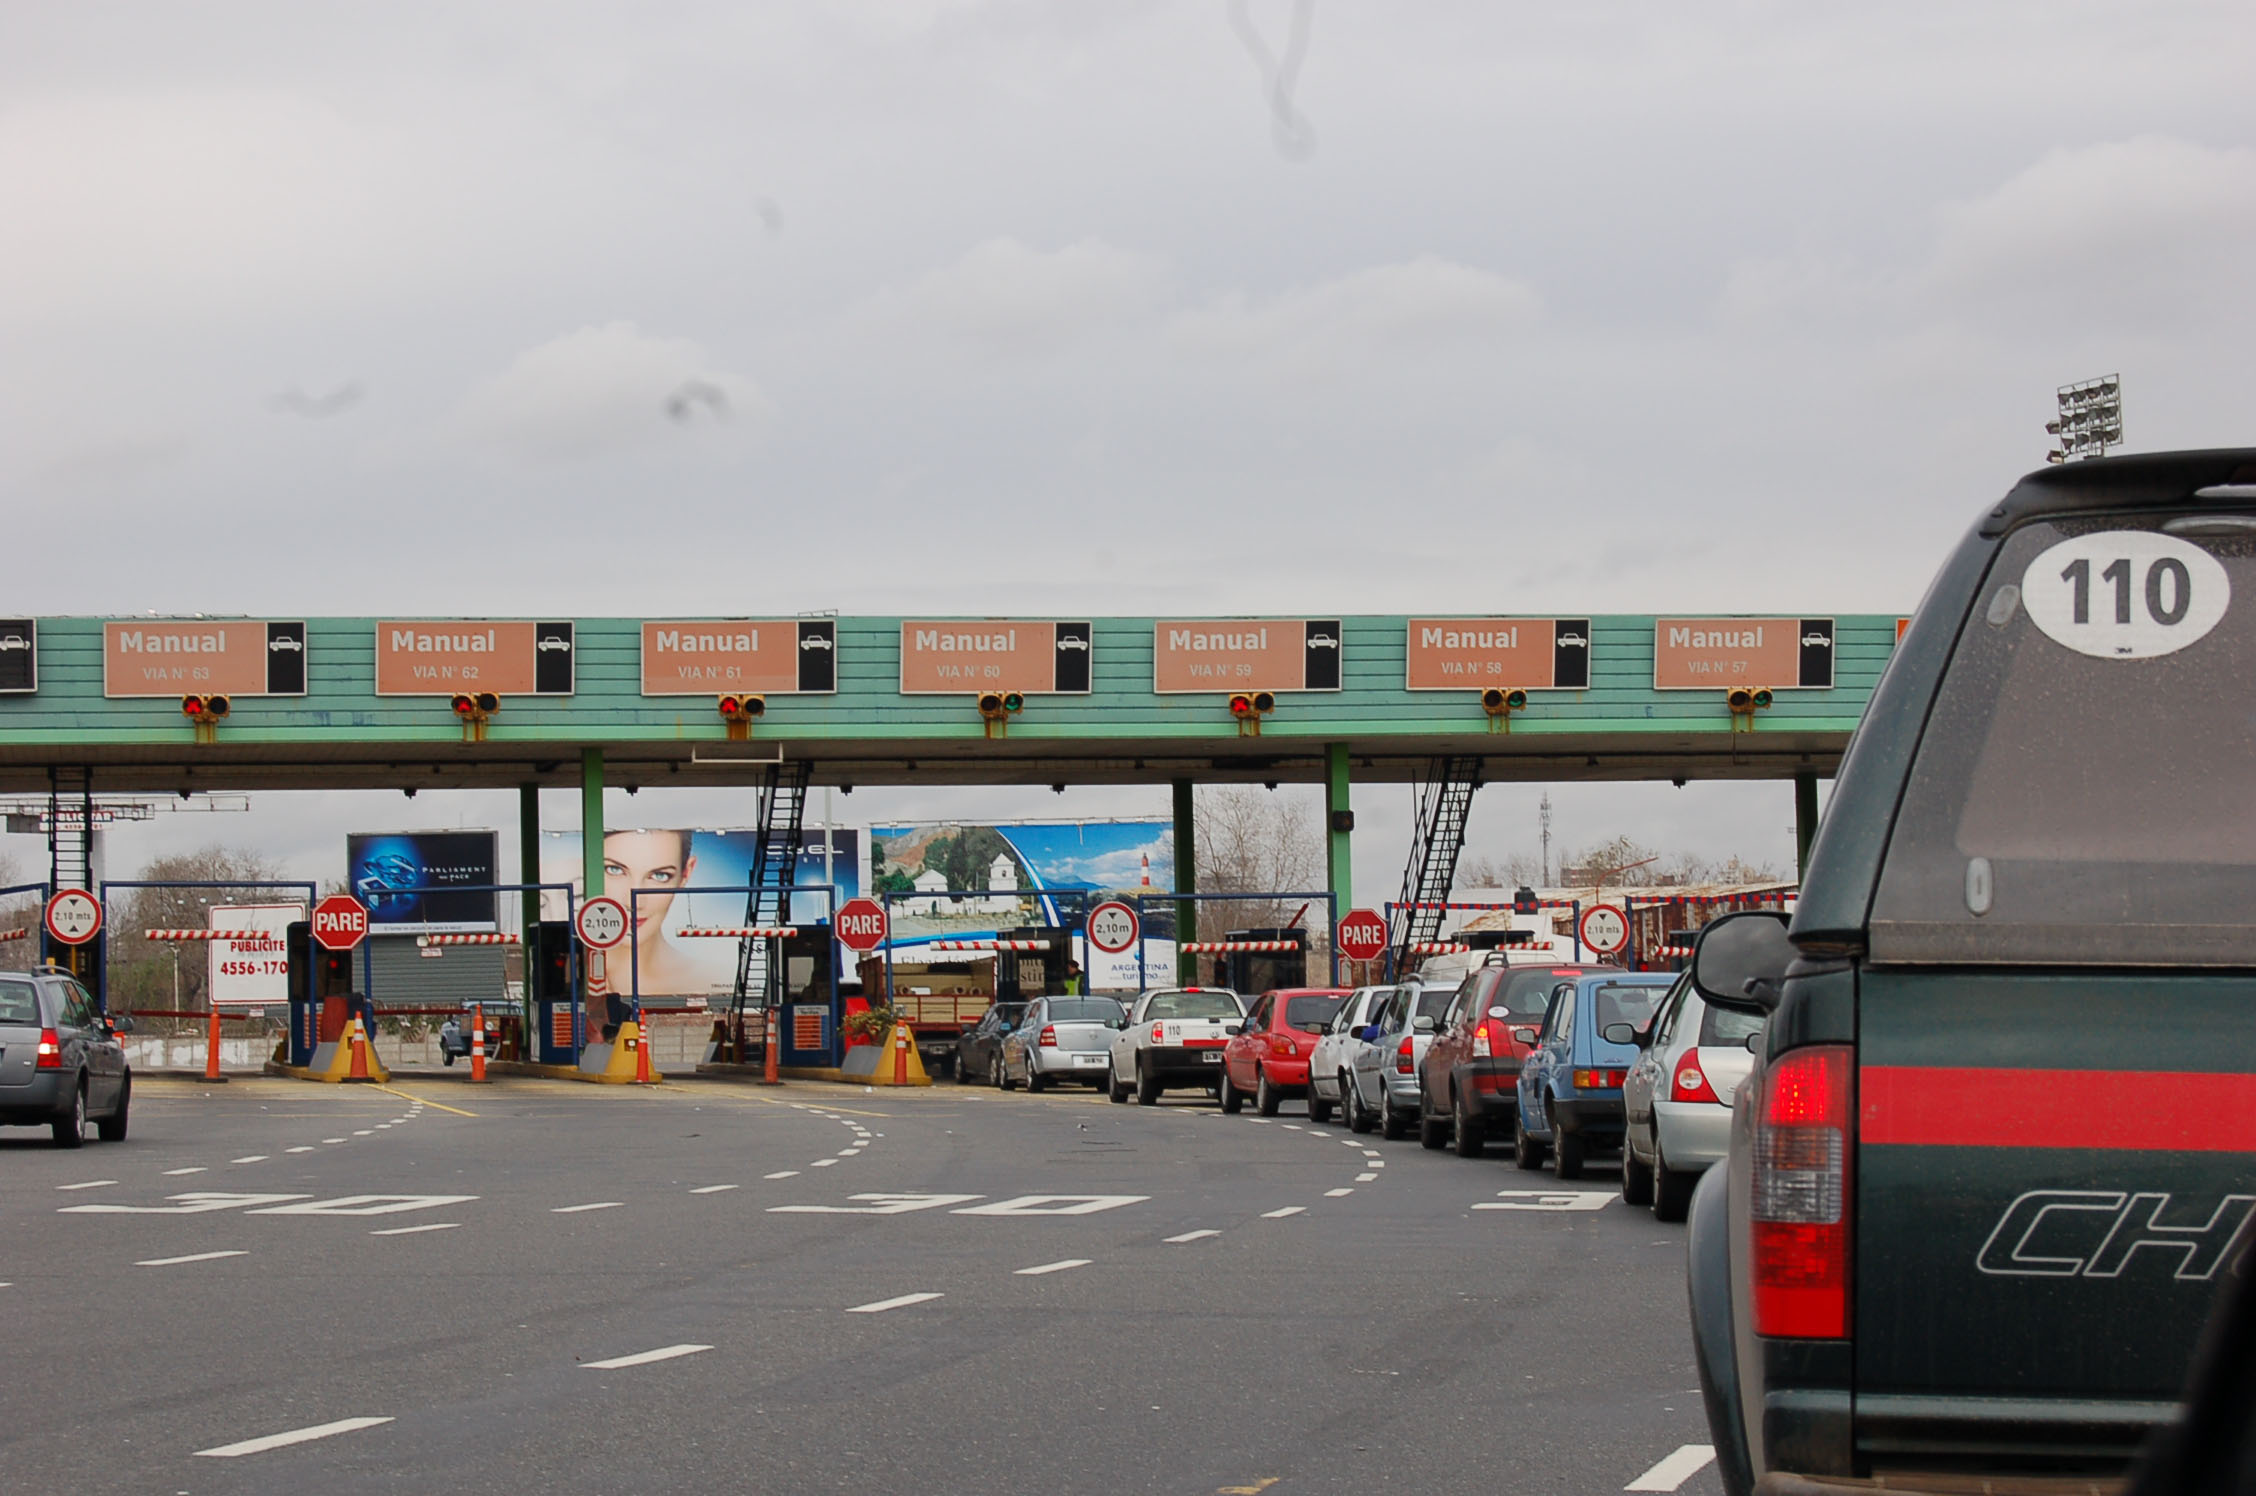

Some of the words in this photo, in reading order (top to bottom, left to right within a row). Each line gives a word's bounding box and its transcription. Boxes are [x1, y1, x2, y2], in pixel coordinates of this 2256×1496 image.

[2060, 557, 2191, 626] 110
[120, 630, 226, 653] Manual
[391, 629, 495, 652] Manual
[656, 629, 759, 652] Manual
[915, 629, 1016, 652] Manual
[1169, 628, 1267, 651] Manual
[1421, 626, 1518, 649] Manual
[1669, 626, 1763, 648] Manual
[143, 667, 168, 680] VIA
[192, 667, 210, 680] 63
[413, 666, 438, 679] VIA
[461, 666, 479, 679] 62
[678, 665, 702, 678] VIA
[726, 665, 742, 678] 61
[937, 665, 961, 677] VIA
[983, 665, 1000, 677] 60
[1189, 664, 1213, 676] VIA
[1235, 664, 1252, 676] 59
[1440, 661, 1464, 674] VIA
[1486, 661, 1502, 674] 58
[1688, 660, 1710, 673] VIA
[1732, 660, 1748, 673] 57
[316, 912, 364, 932] PARE
[840, 914, 882, 936] PARE
[1342, 924, 1382, 946] PARE
[230, 940, 285, 953] PUBLICITE
[1111, 963, 1169, 972] ARGETINA
[1122, 972, 1159, 981] turimo
[1168, 1025, 1182, 1036] 110
